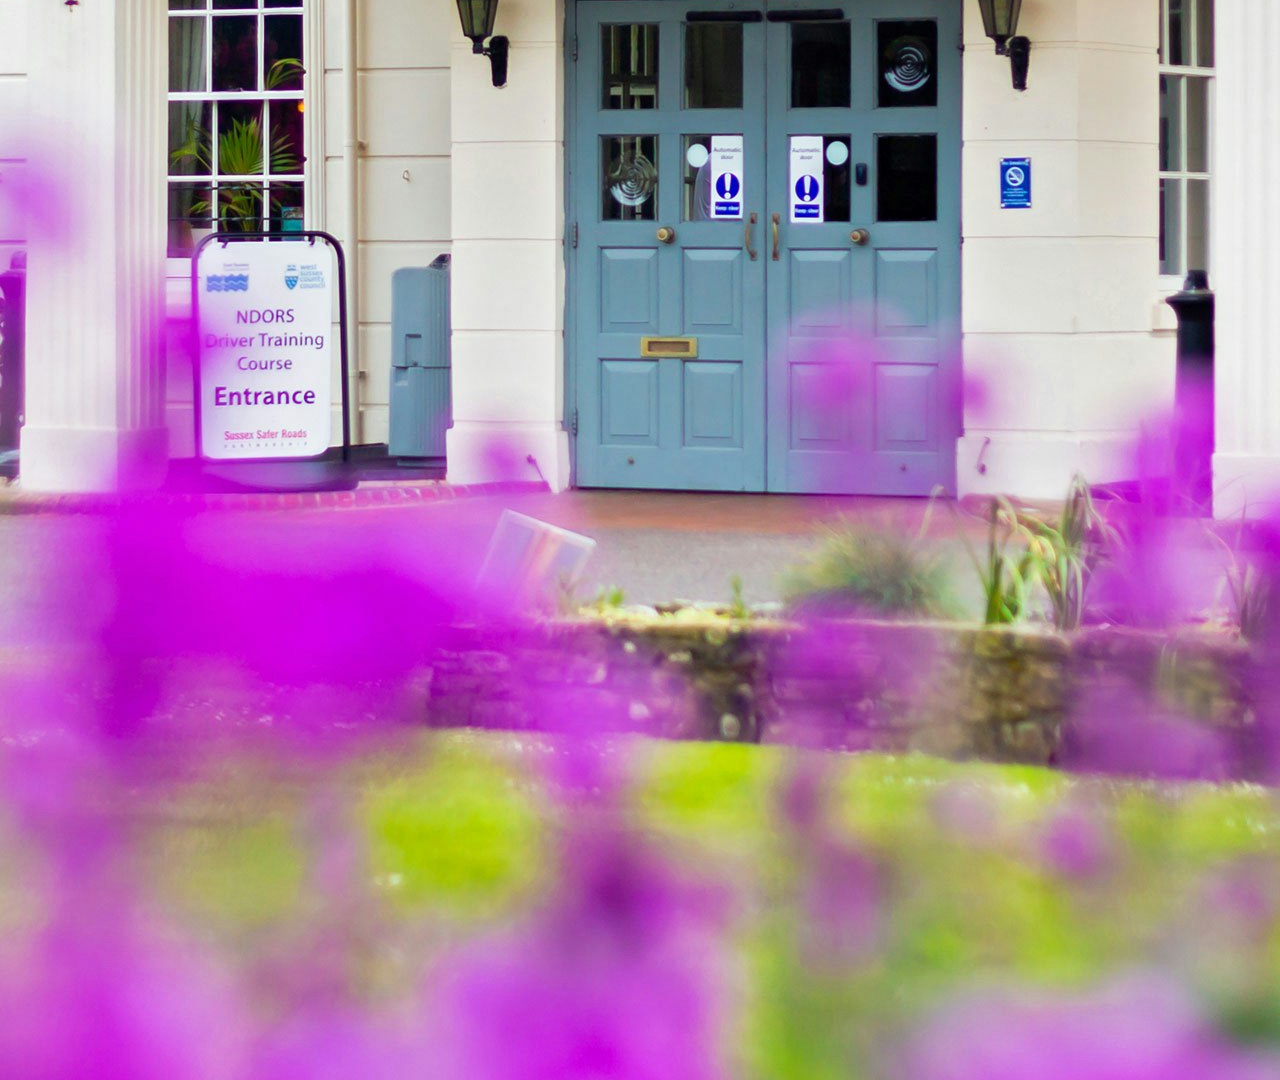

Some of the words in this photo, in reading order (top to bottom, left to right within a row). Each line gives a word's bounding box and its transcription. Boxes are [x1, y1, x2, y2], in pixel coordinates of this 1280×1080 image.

[236, 308, 295, 324] NDORS
[205, 332, 255, 348] Driver
[258, 331, 325, 350] Training
[237, 356, 293, 371] Course
[214, 386, 316, 406] Entrance
[224, 430, 254, 441] Sussex
[256, 429, 279, 440] Safer
[281, 428, 308, 439] Roads
